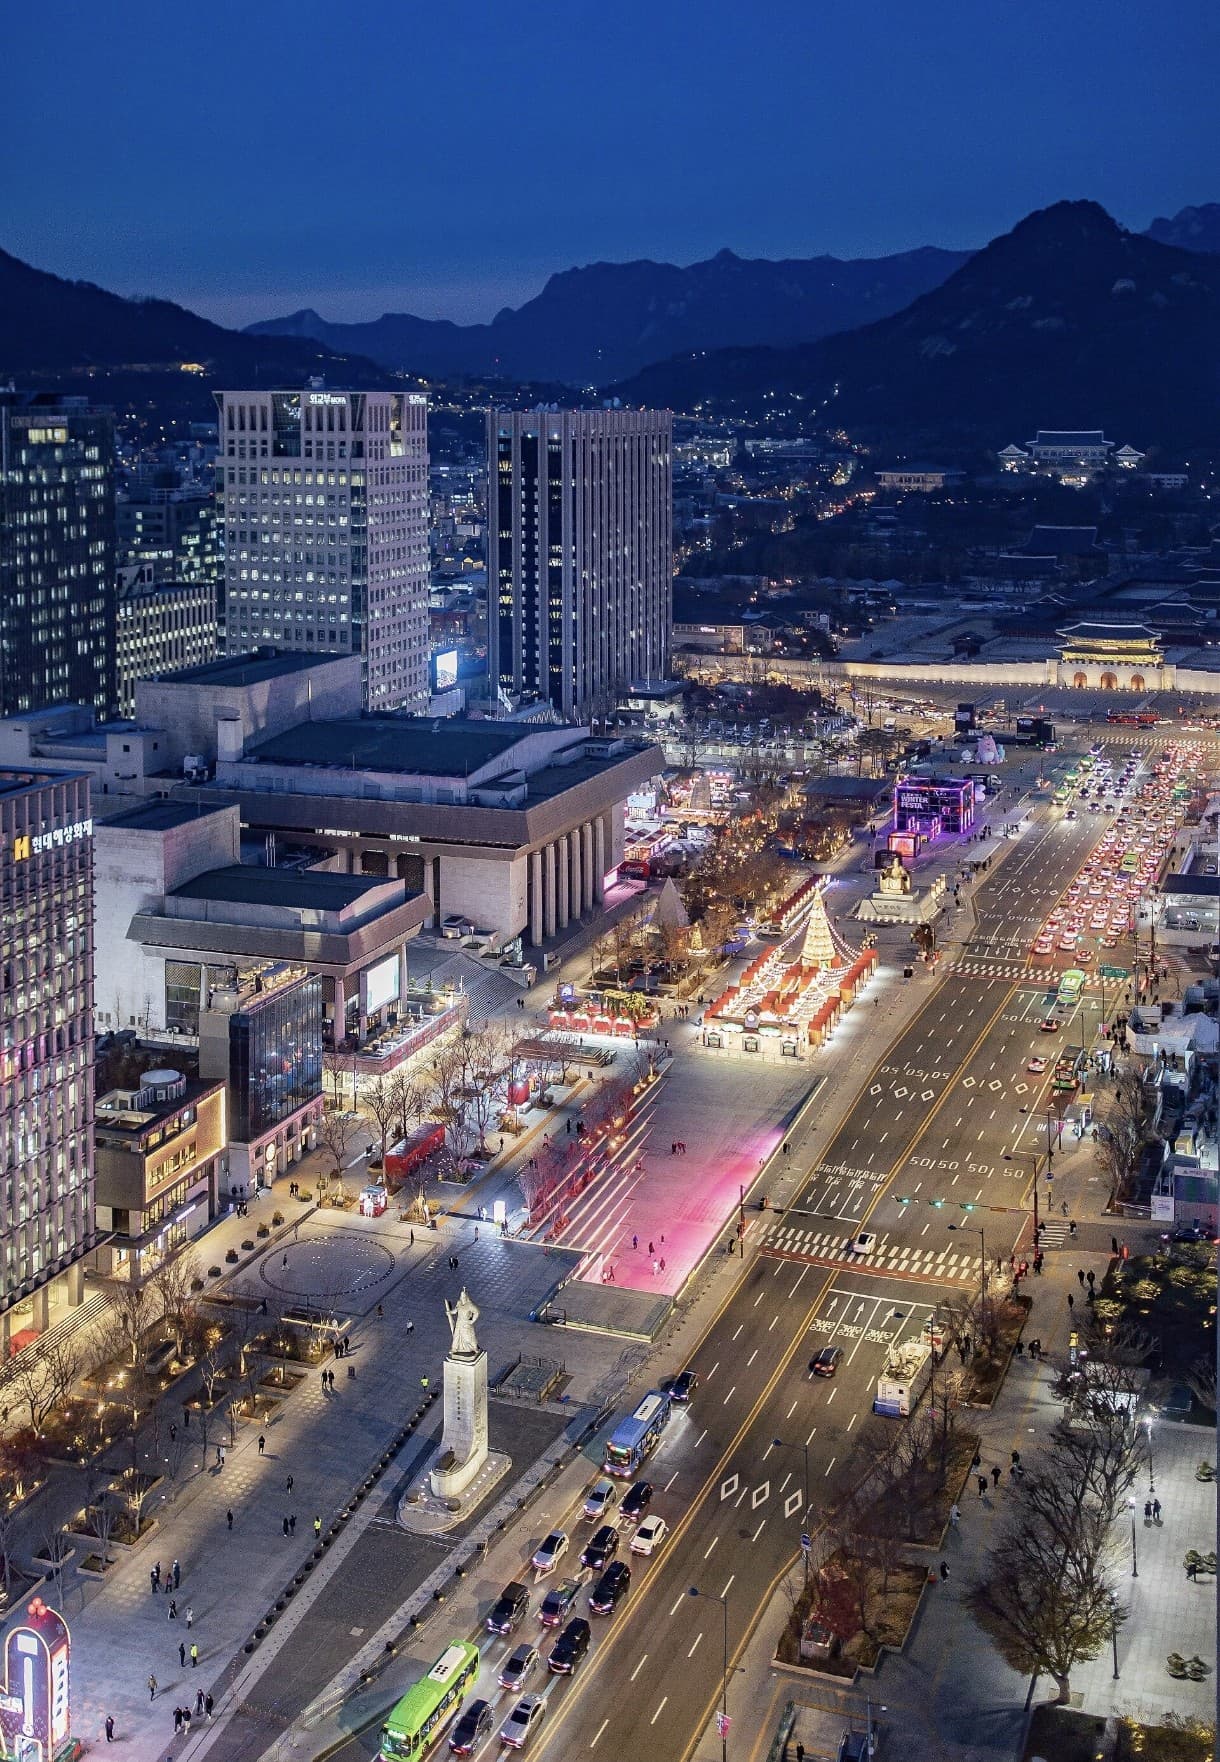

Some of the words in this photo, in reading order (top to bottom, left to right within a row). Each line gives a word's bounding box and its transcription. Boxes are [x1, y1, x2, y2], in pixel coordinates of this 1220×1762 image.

[901, 795, 928, 803] WINTER
[32, 819, 93, 854] 현대해상화재
[905, 1069, 924, 1077] 50
[931, 1071, 950, 1080] 50
[909, 1156, 930, 1167] 50
[937, 1160, 959, 1170] 50
[967, 1163, 988, 1174] 50
[1003, 1168, 1024, 1178] 50
